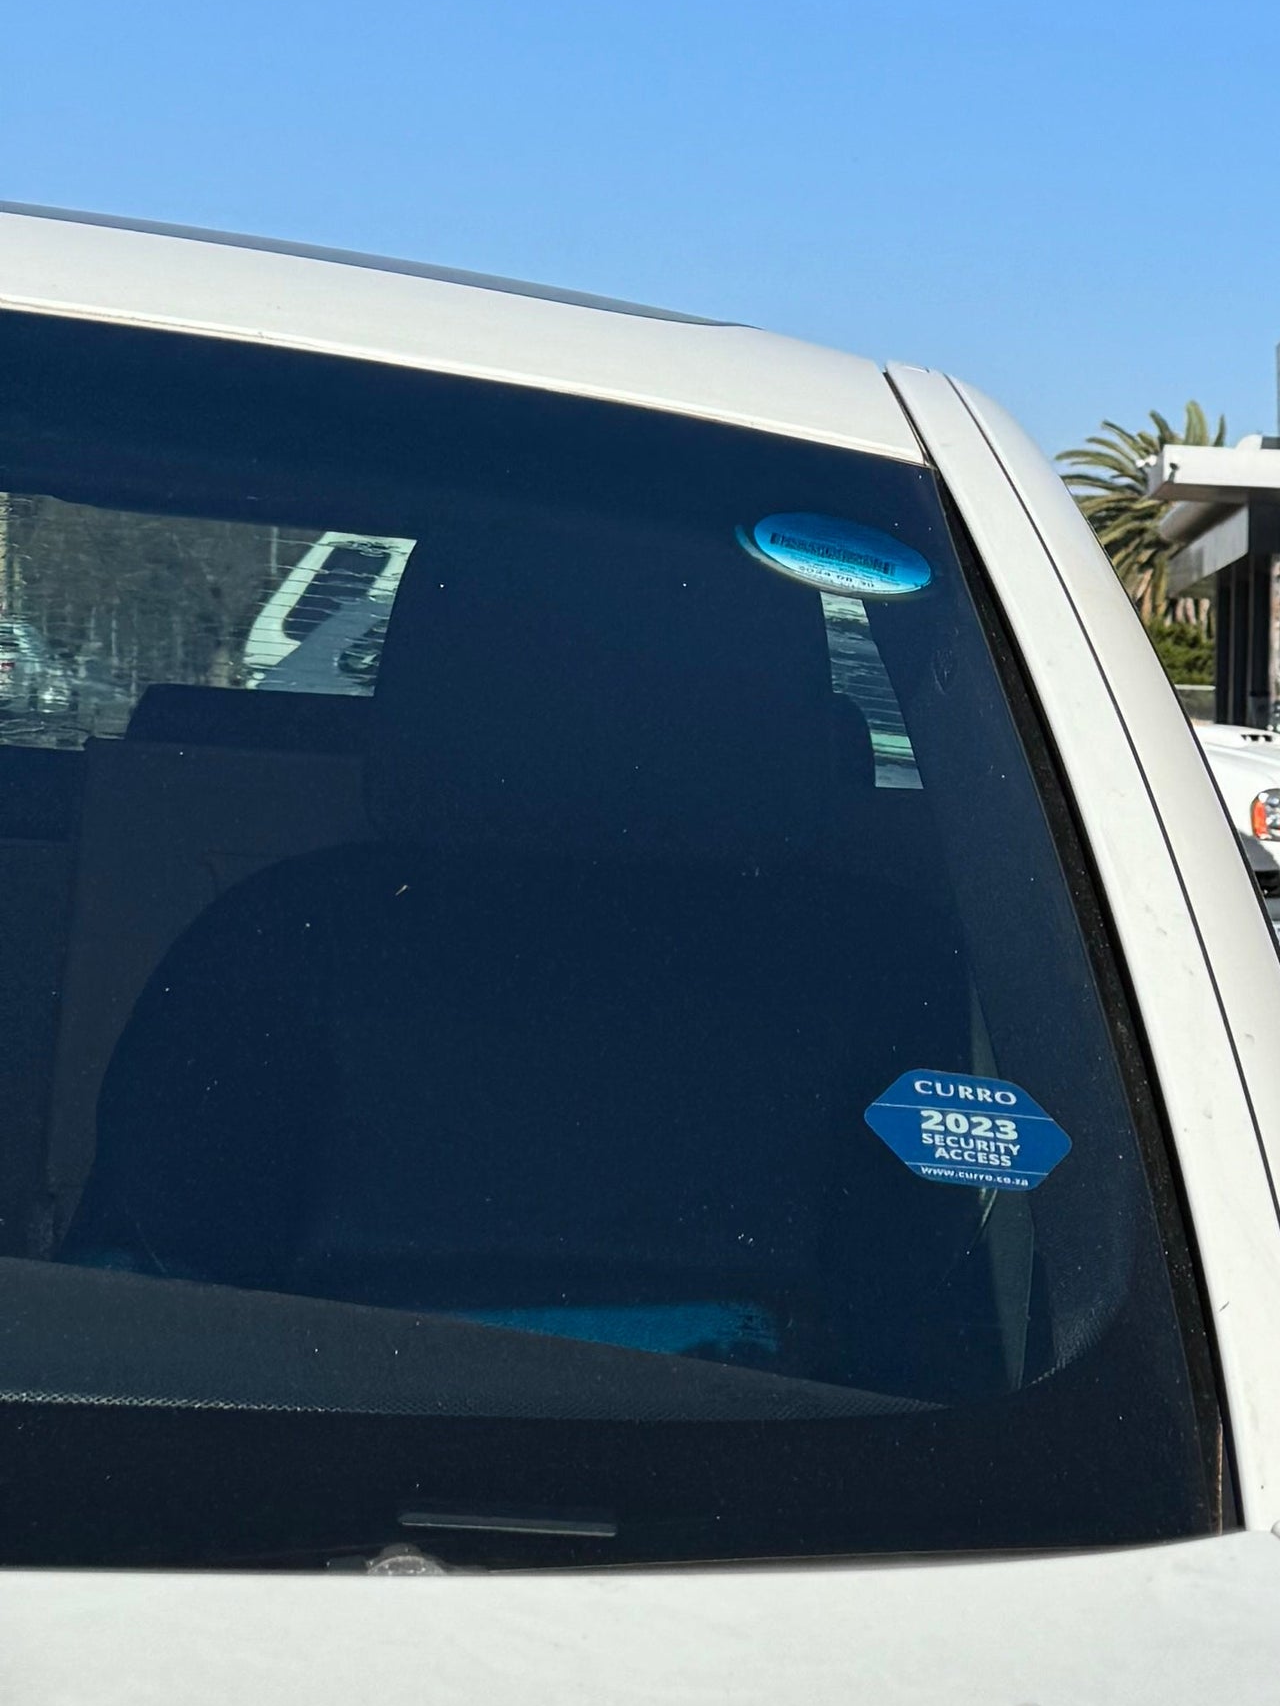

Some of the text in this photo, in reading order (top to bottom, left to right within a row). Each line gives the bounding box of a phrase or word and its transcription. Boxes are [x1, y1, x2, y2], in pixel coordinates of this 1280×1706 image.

[914, 1080, 1018, 1105] CURRO
[920, 1109, 1019, 1141] 2023
[921, 1133, 1021, 1156] SECURITY
[935, 1147, 1012, 1167] ACCESS
[921, 1165, 1029, 1186] www.curro.co.za
